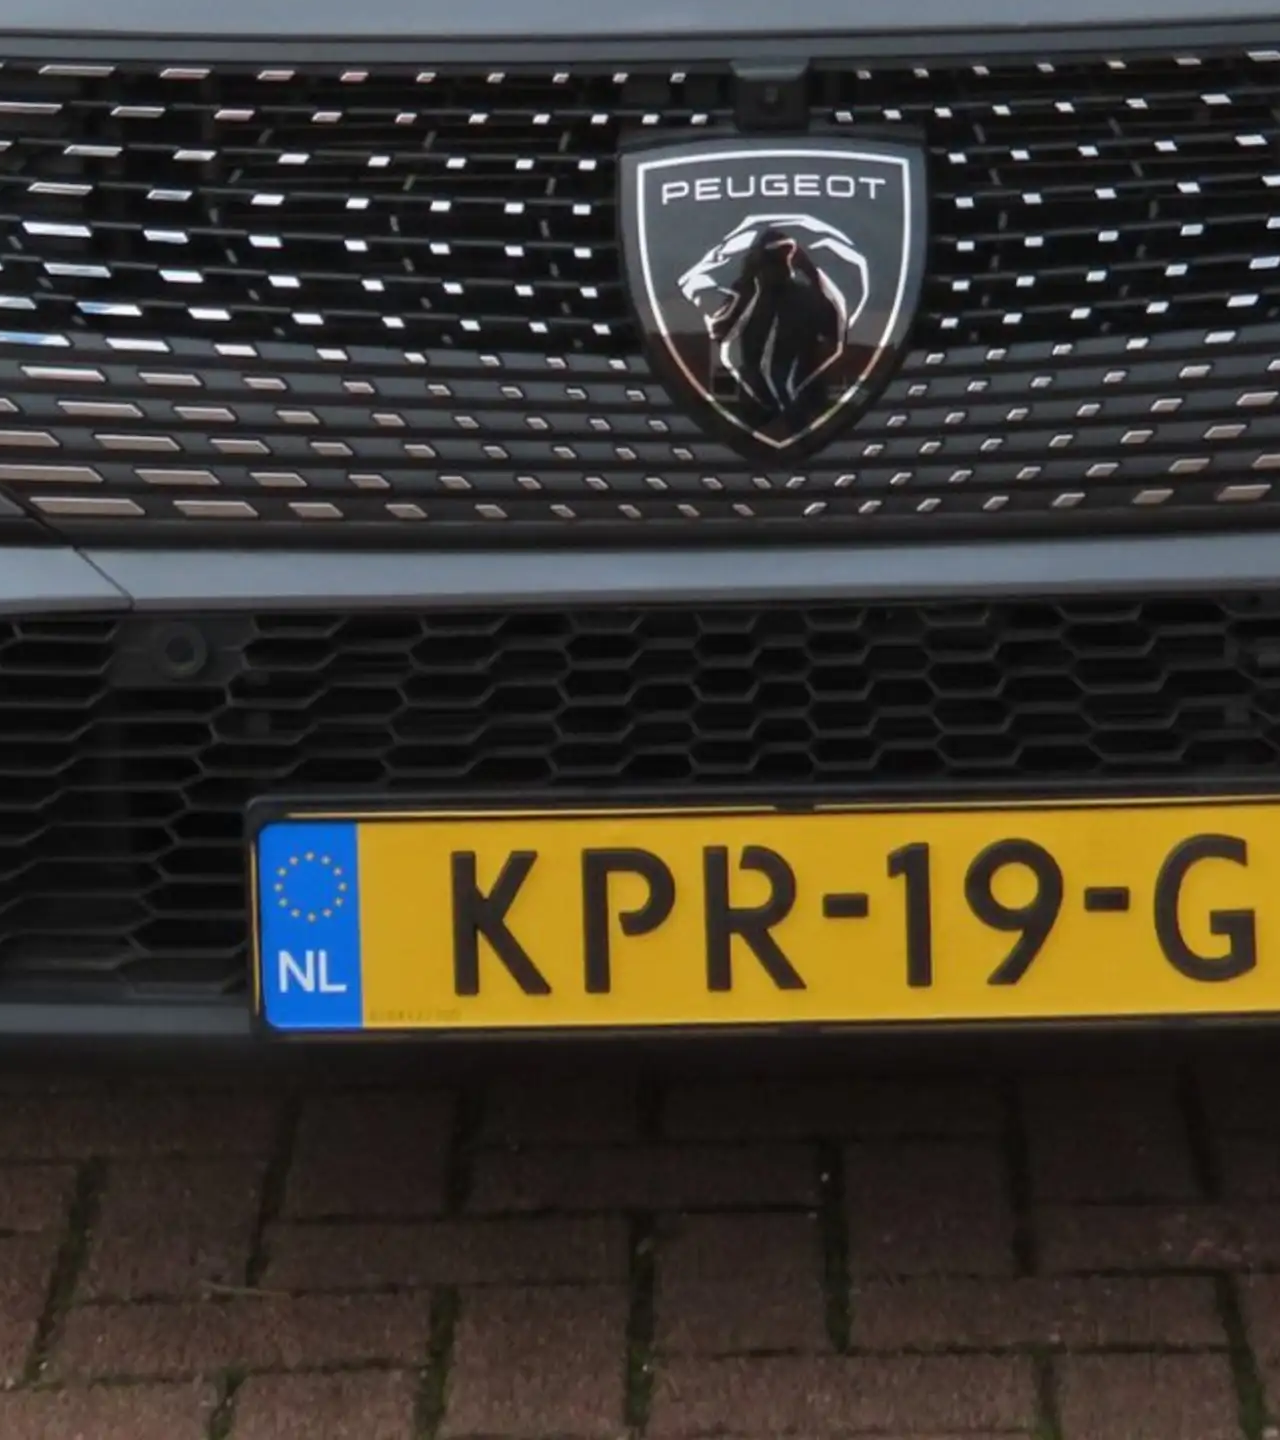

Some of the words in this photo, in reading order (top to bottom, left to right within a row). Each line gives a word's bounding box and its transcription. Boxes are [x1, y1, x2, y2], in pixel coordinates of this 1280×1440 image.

[661, 173, 886, 205] PEUGEOT
[279, 951, 346, 992] NL
[451, 834, 1256, 996] KPR-19-G
